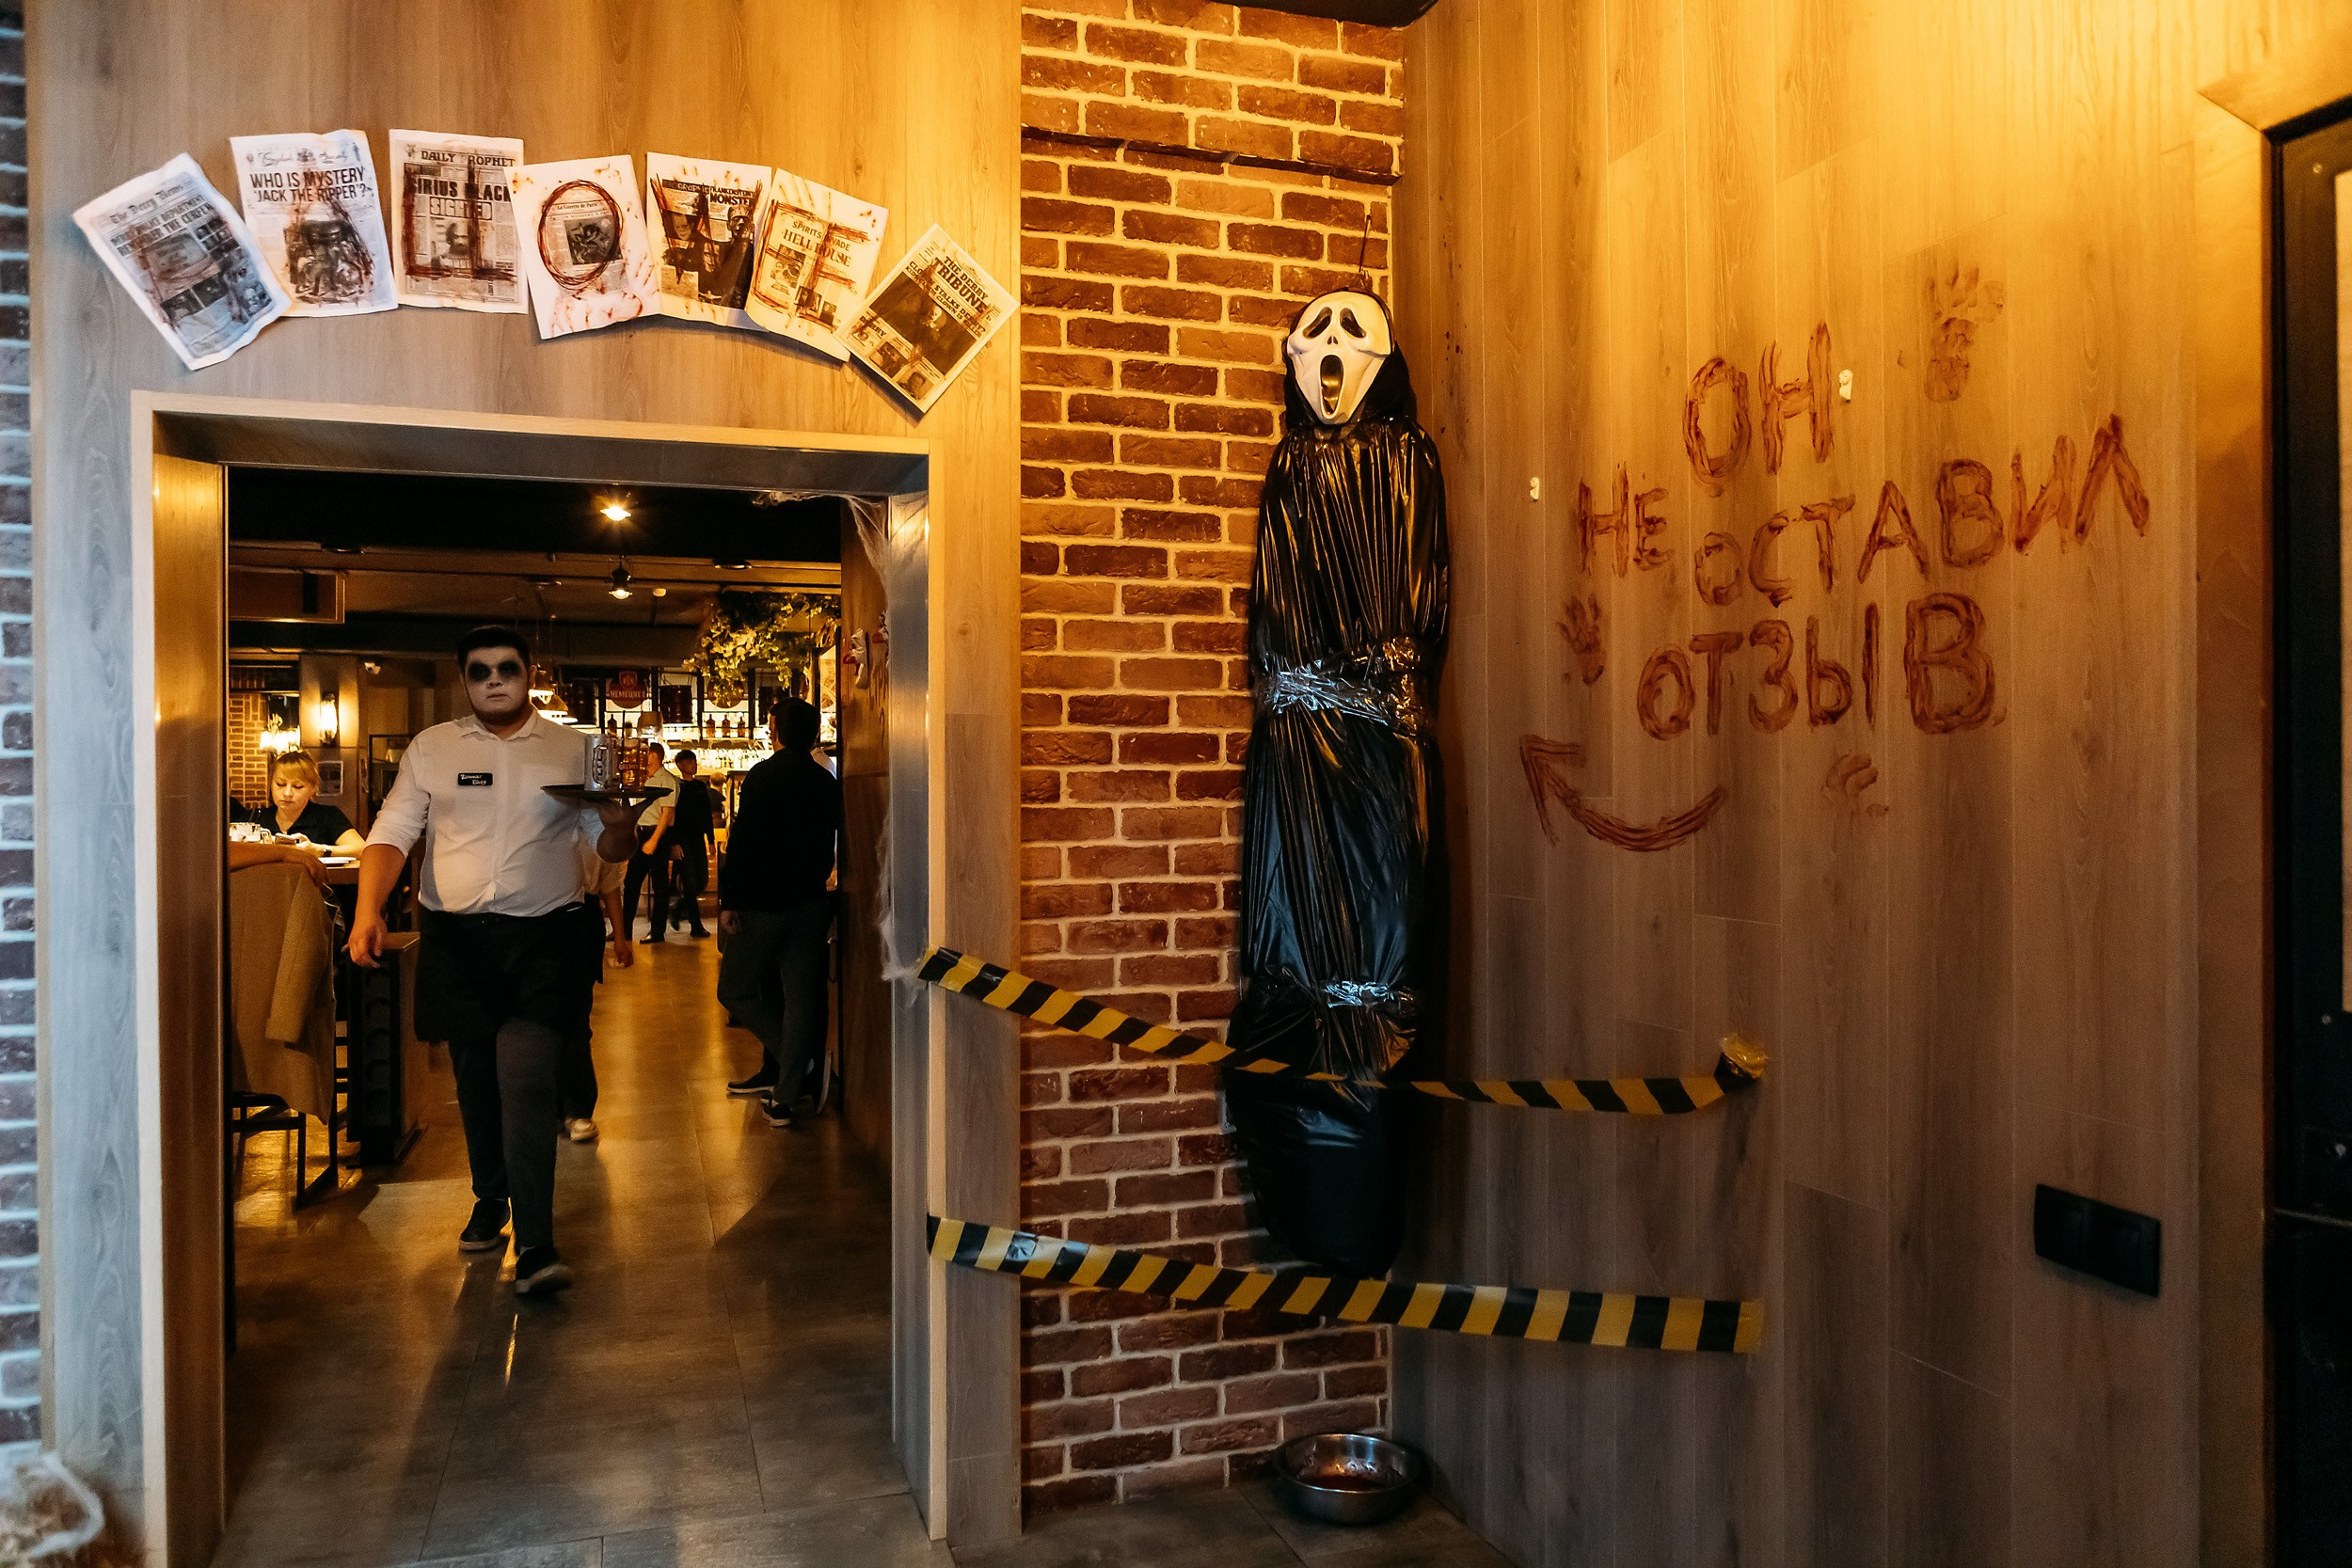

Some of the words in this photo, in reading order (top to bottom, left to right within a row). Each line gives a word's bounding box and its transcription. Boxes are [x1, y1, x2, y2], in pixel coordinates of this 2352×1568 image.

[421, 150, 456, 163] DAILY
[250, 172, 283, 188] WHO
[288, 172, 300, 187] IS
[304, 166, 364, 187] MYSTERY
[289, 188, 313, 202] THE
[709, 193, 752, 205] MONSTE
[784, 229, 812, 251] HELL
[792, 221, 822, 239] SPIRITS
[930, 257, 989, 314] TRIBUNE
[943, 256, 961, 275] THE
[960, 273, 988, 300] DERRY
[933, 285, 959, 309] STALKS
[1681, 321, 1836, 485] ОН
[1575, 461, 1675, 578] НЕ
[1692, 414, 2152, 608] ОСТАВИЛ
[1637, 591, 1998, 741] ОТЗЫВ
